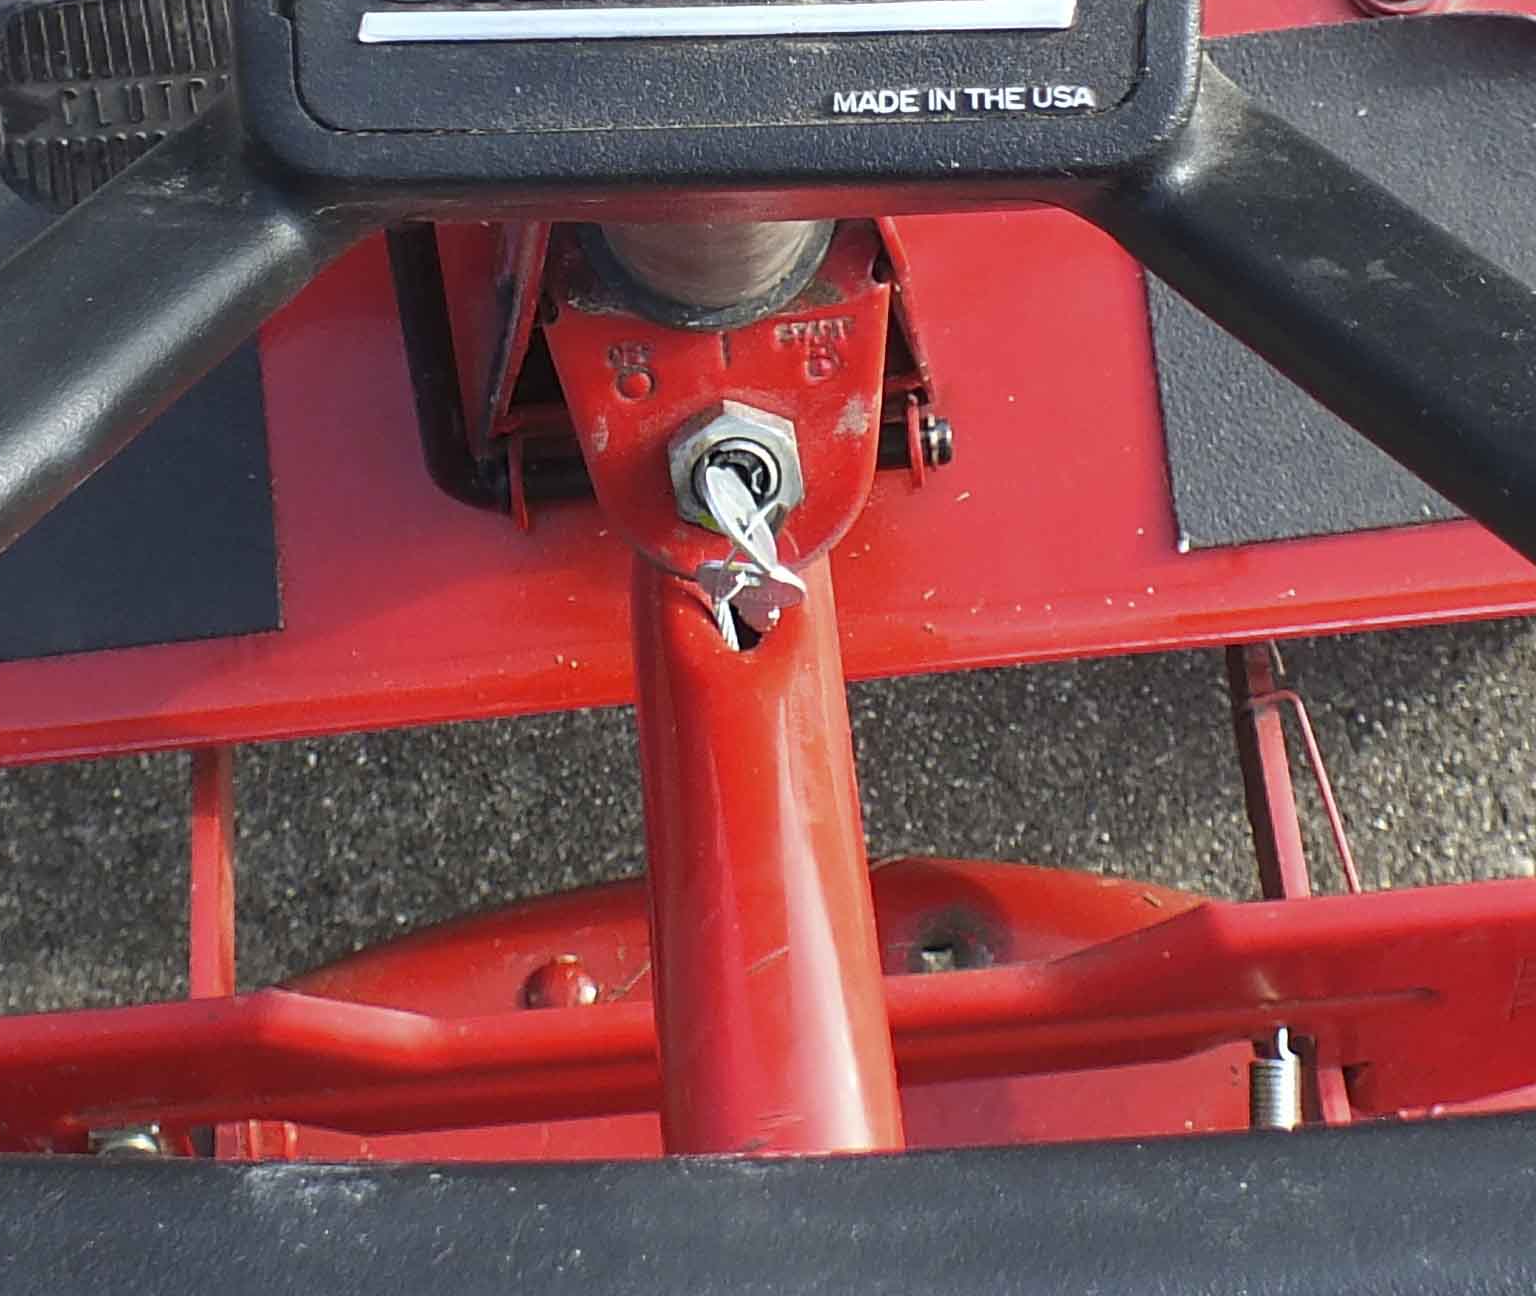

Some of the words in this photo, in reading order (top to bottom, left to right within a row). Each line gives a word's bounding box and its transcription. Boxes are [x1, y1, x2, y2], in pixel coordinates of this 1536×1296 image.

[58, 74, 231, 127] CLUTC
[832, 90, 919, 114] MADE
[927, 89, 957, 112] IN
[964, 87, 1026, 111] THE
[1032, 86, 1096, 108] USA
